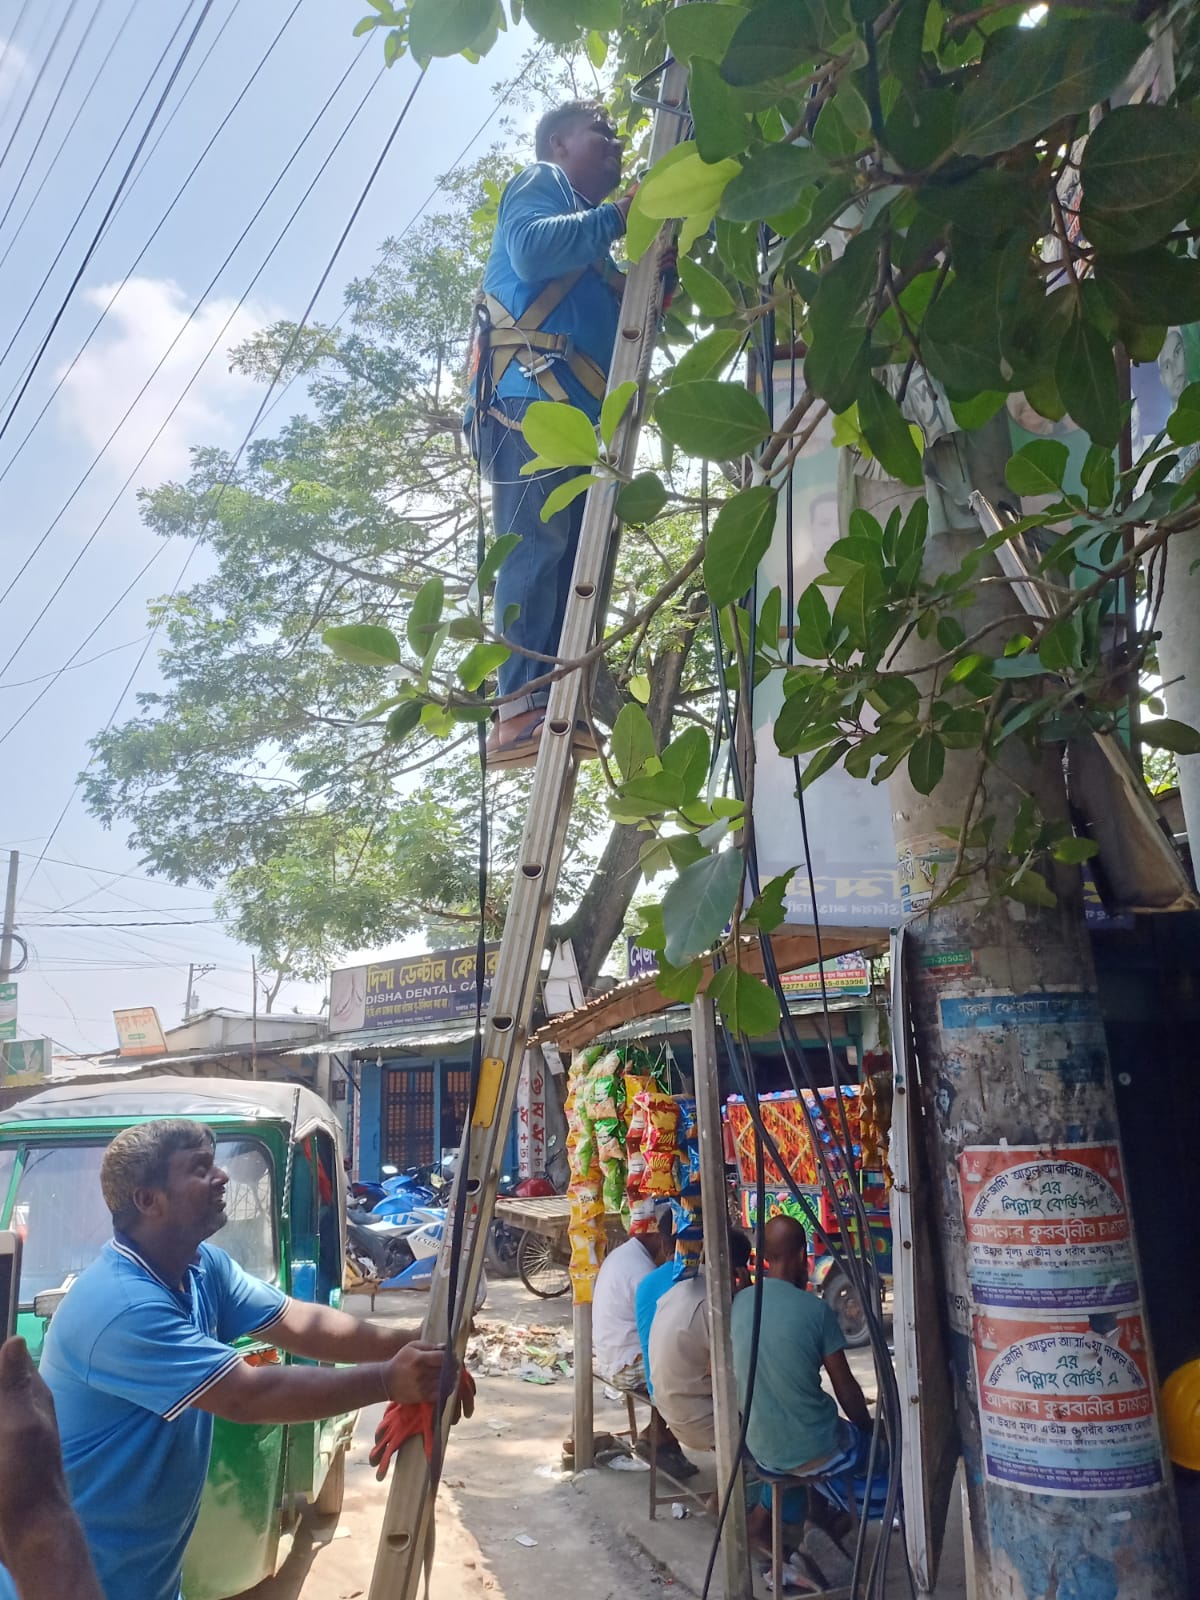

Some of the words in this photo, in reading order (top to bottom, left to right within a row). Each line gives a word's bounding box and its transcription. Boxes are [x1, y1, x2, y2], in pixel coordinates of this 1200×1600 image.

[368, 965, 394, 993] দিশা
[400, 958, 446, 986] ডেন্টাল
[366, 992, 402, 1005] DISHA
[406, 984, 456, 999] DENTAL
[1040, 1180, 1061, 1195] এর
[1056, 1354, 1078, 1370] এর
[1062, 1365, 1104, 1388] বোর্ডিং
[1107, 1371, 1119, 1387] এ
